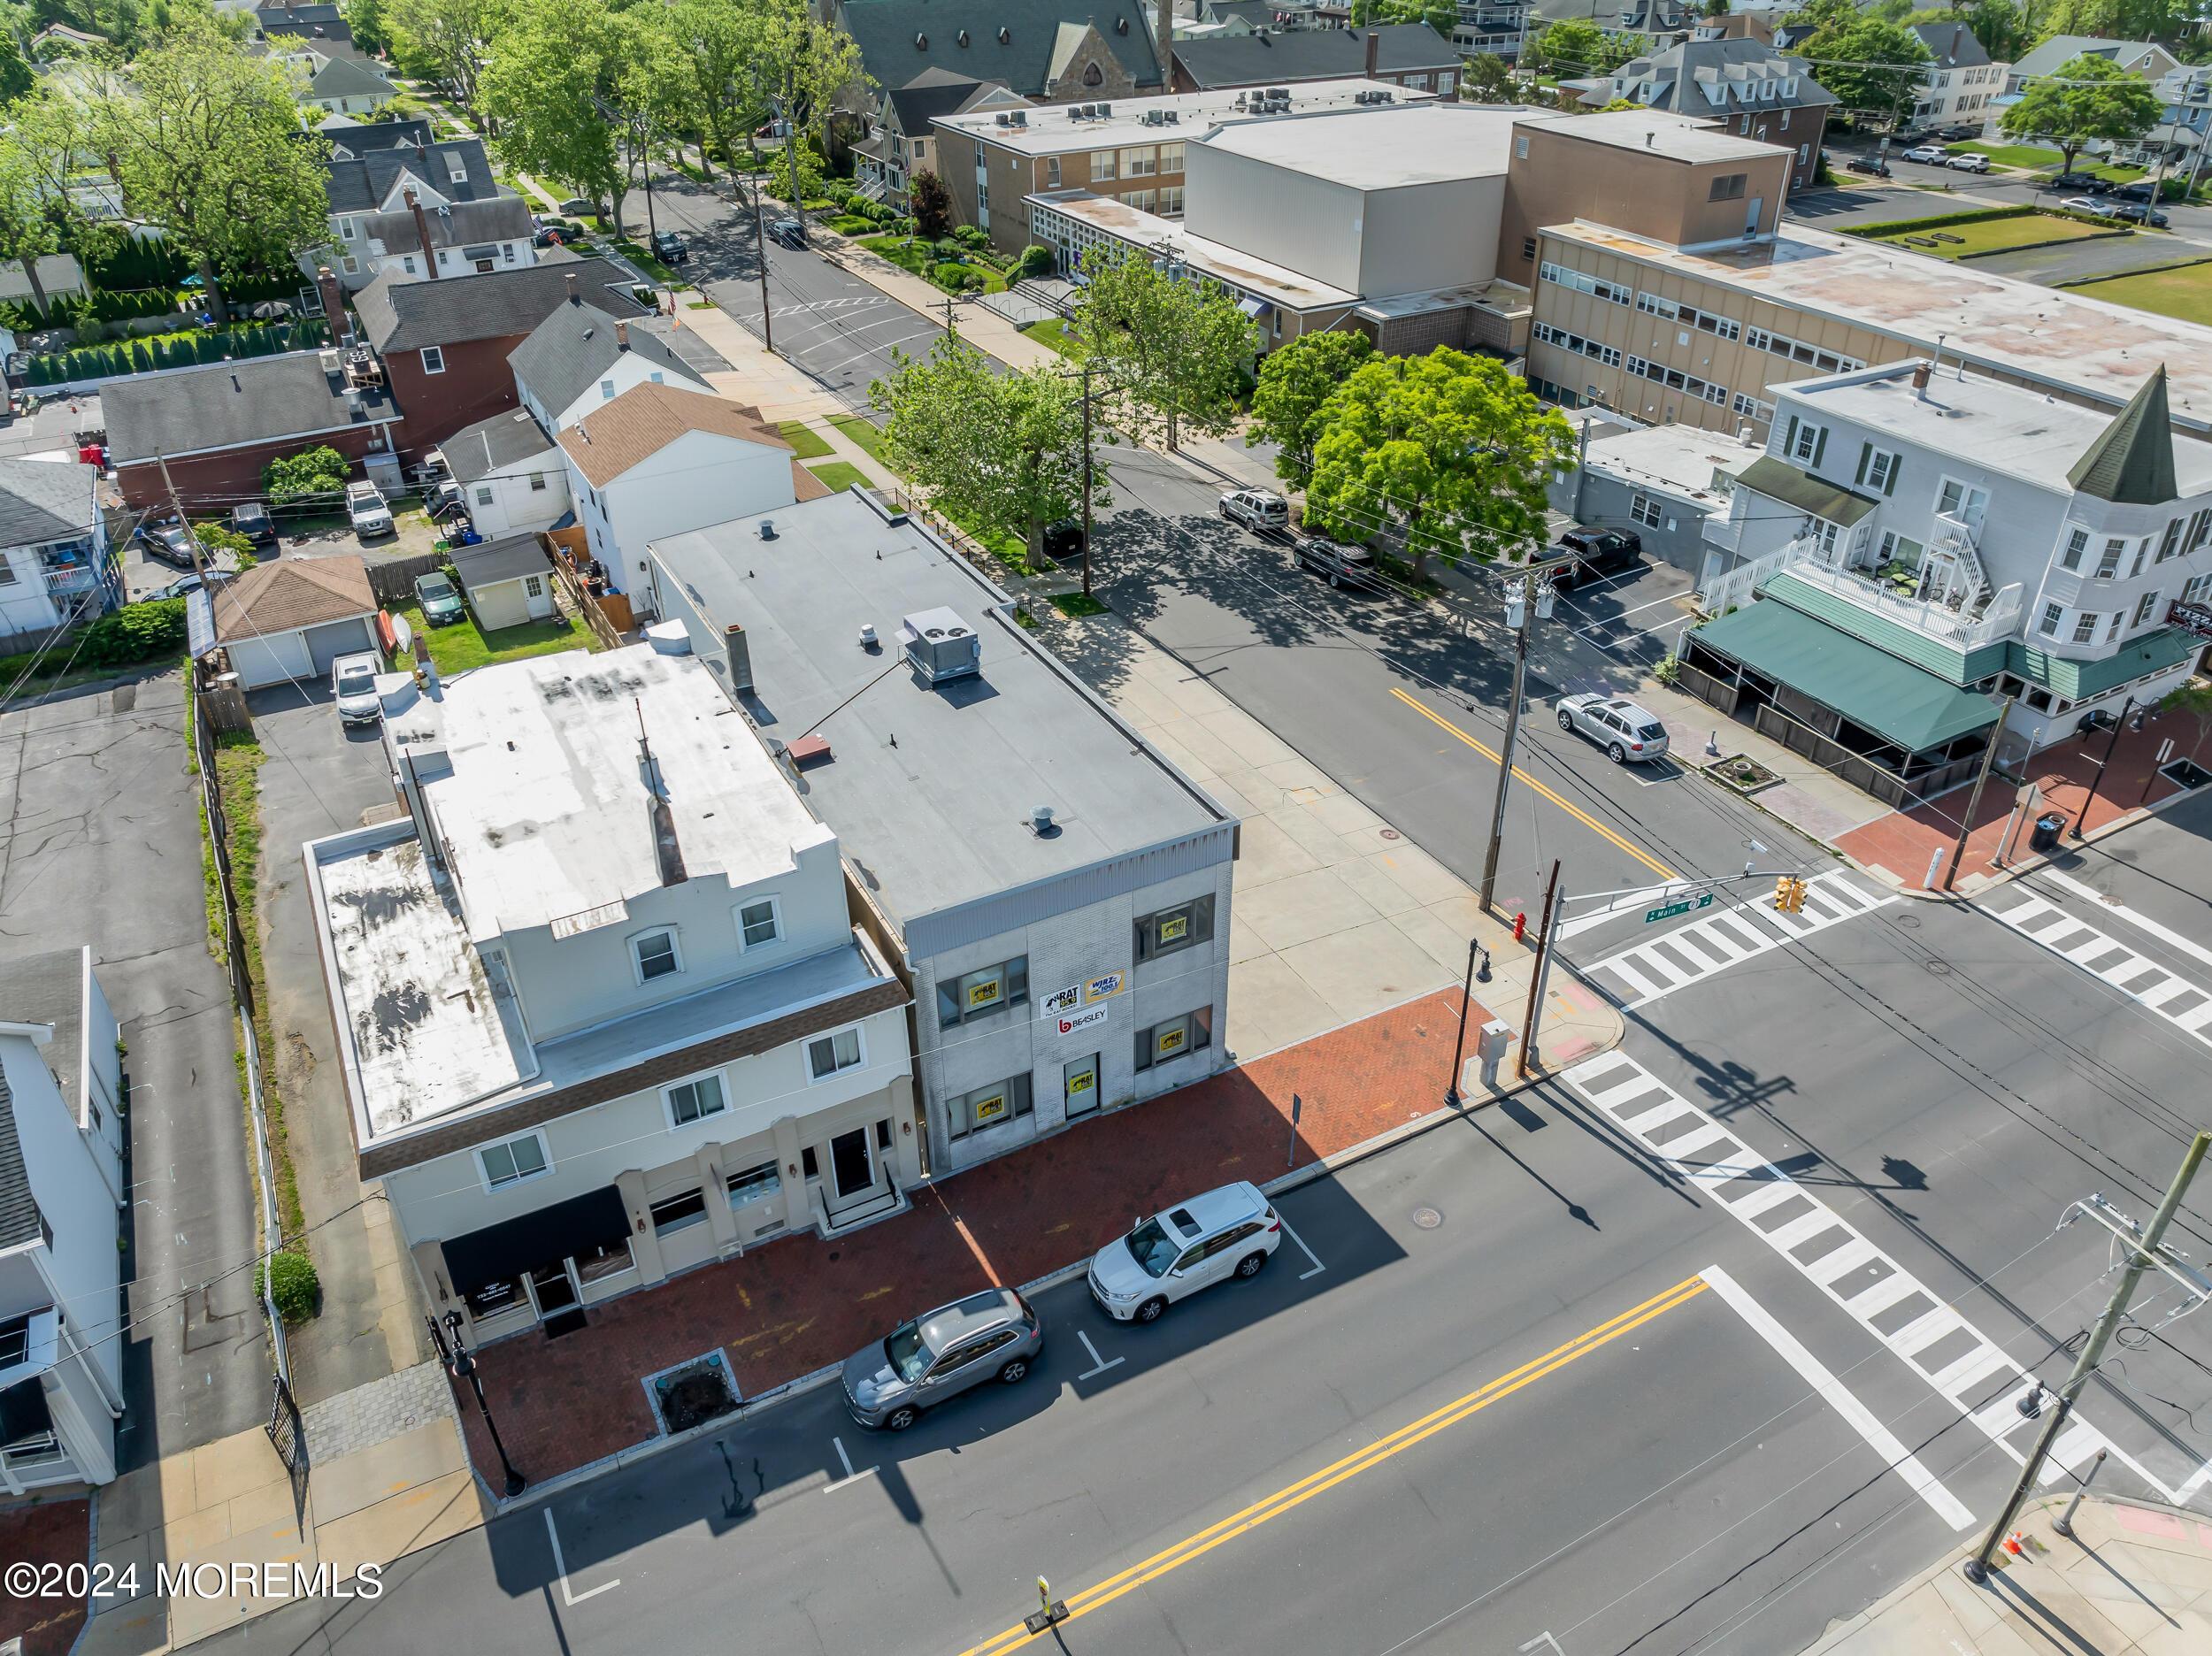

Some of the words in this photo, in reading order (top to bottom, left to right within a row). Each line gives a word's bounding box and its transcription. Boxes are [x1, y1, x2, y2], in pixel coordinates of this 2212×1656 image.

[2176, 606, 2212, 626] PIZZ
[1657, 908, 1676, 917] Main
[1072, 1009, 1106, 1028] BEASLEY
